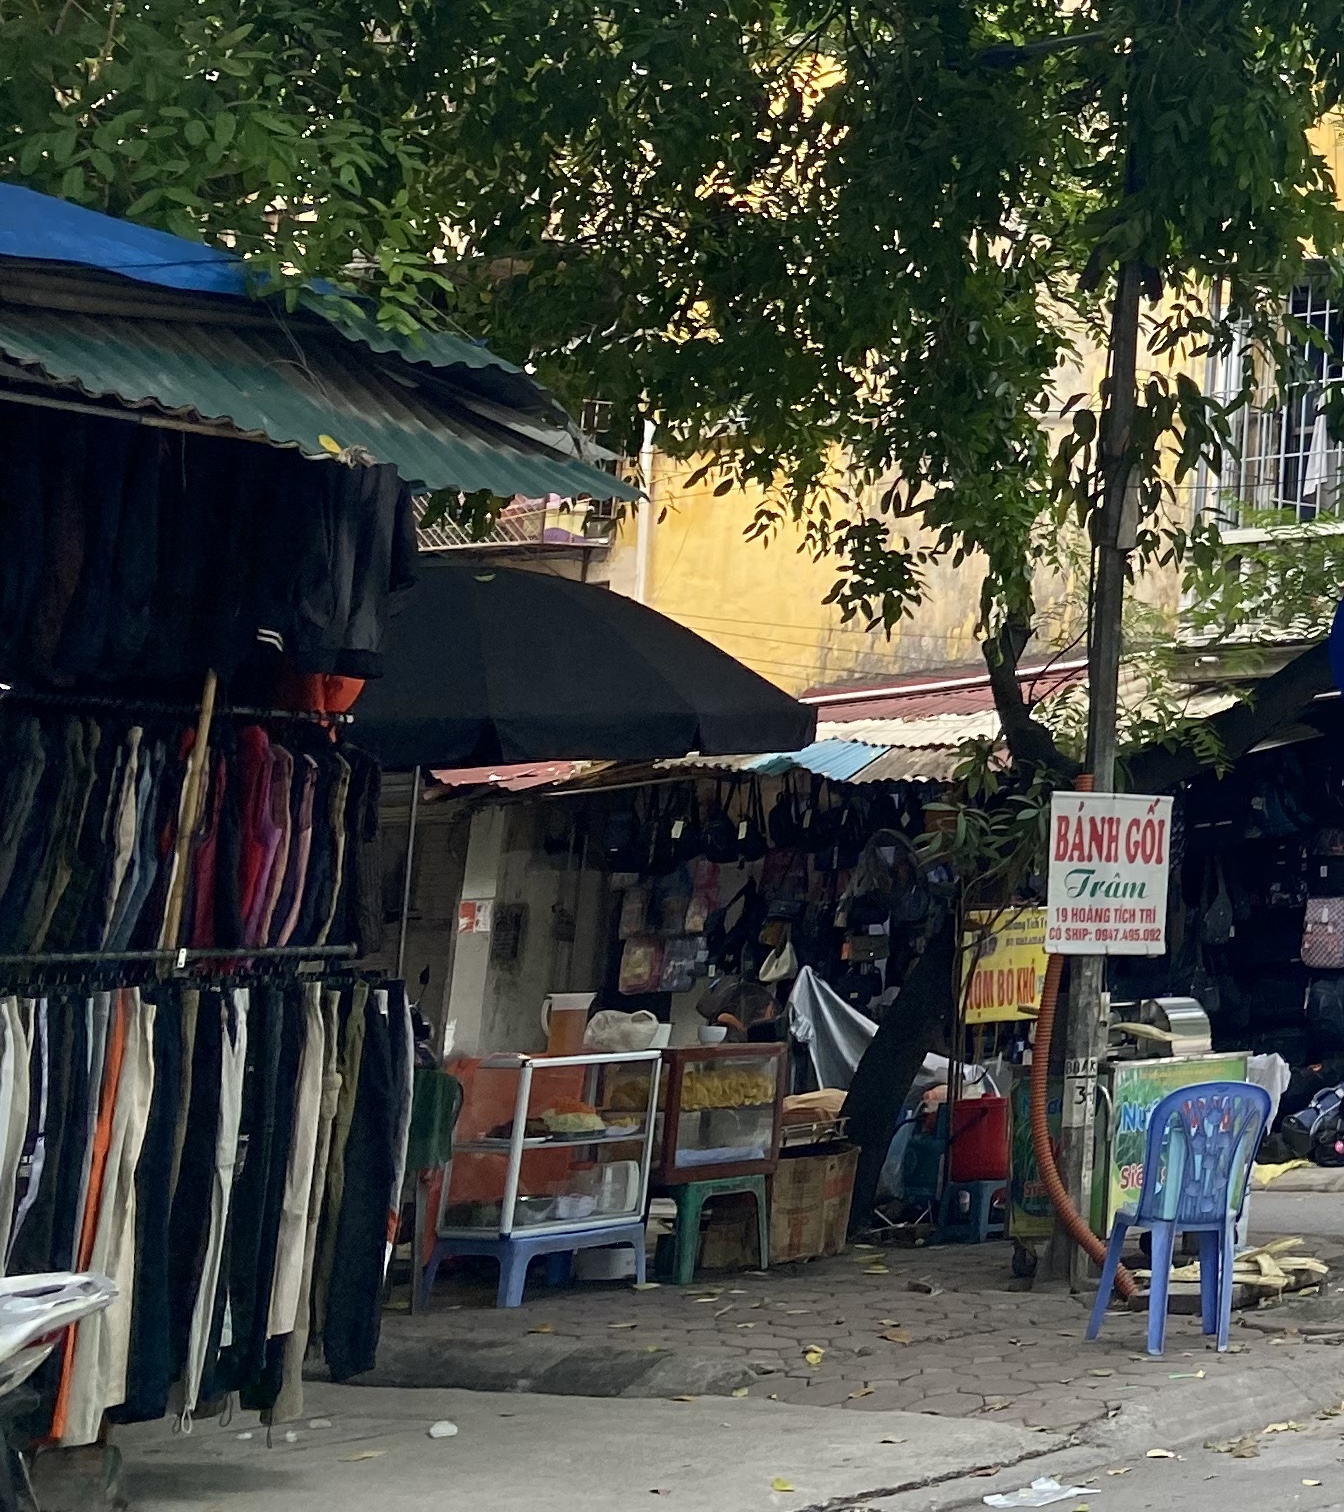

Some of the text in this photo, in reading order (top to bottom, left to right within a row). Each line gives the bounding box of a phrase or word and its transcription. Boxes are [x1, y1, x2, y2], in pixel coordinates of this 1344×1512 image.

[1054, 798, 1165, 865] BÁNH GỐI
[1064, 868, 1148, 899] Trâm
[1055, 904, 1157, 924] 19 HOÀNG TÍCH TRÍ
[1049, 925, 1062, 941] CÓ
[1065, 927, 1093, 941] SHIP:
